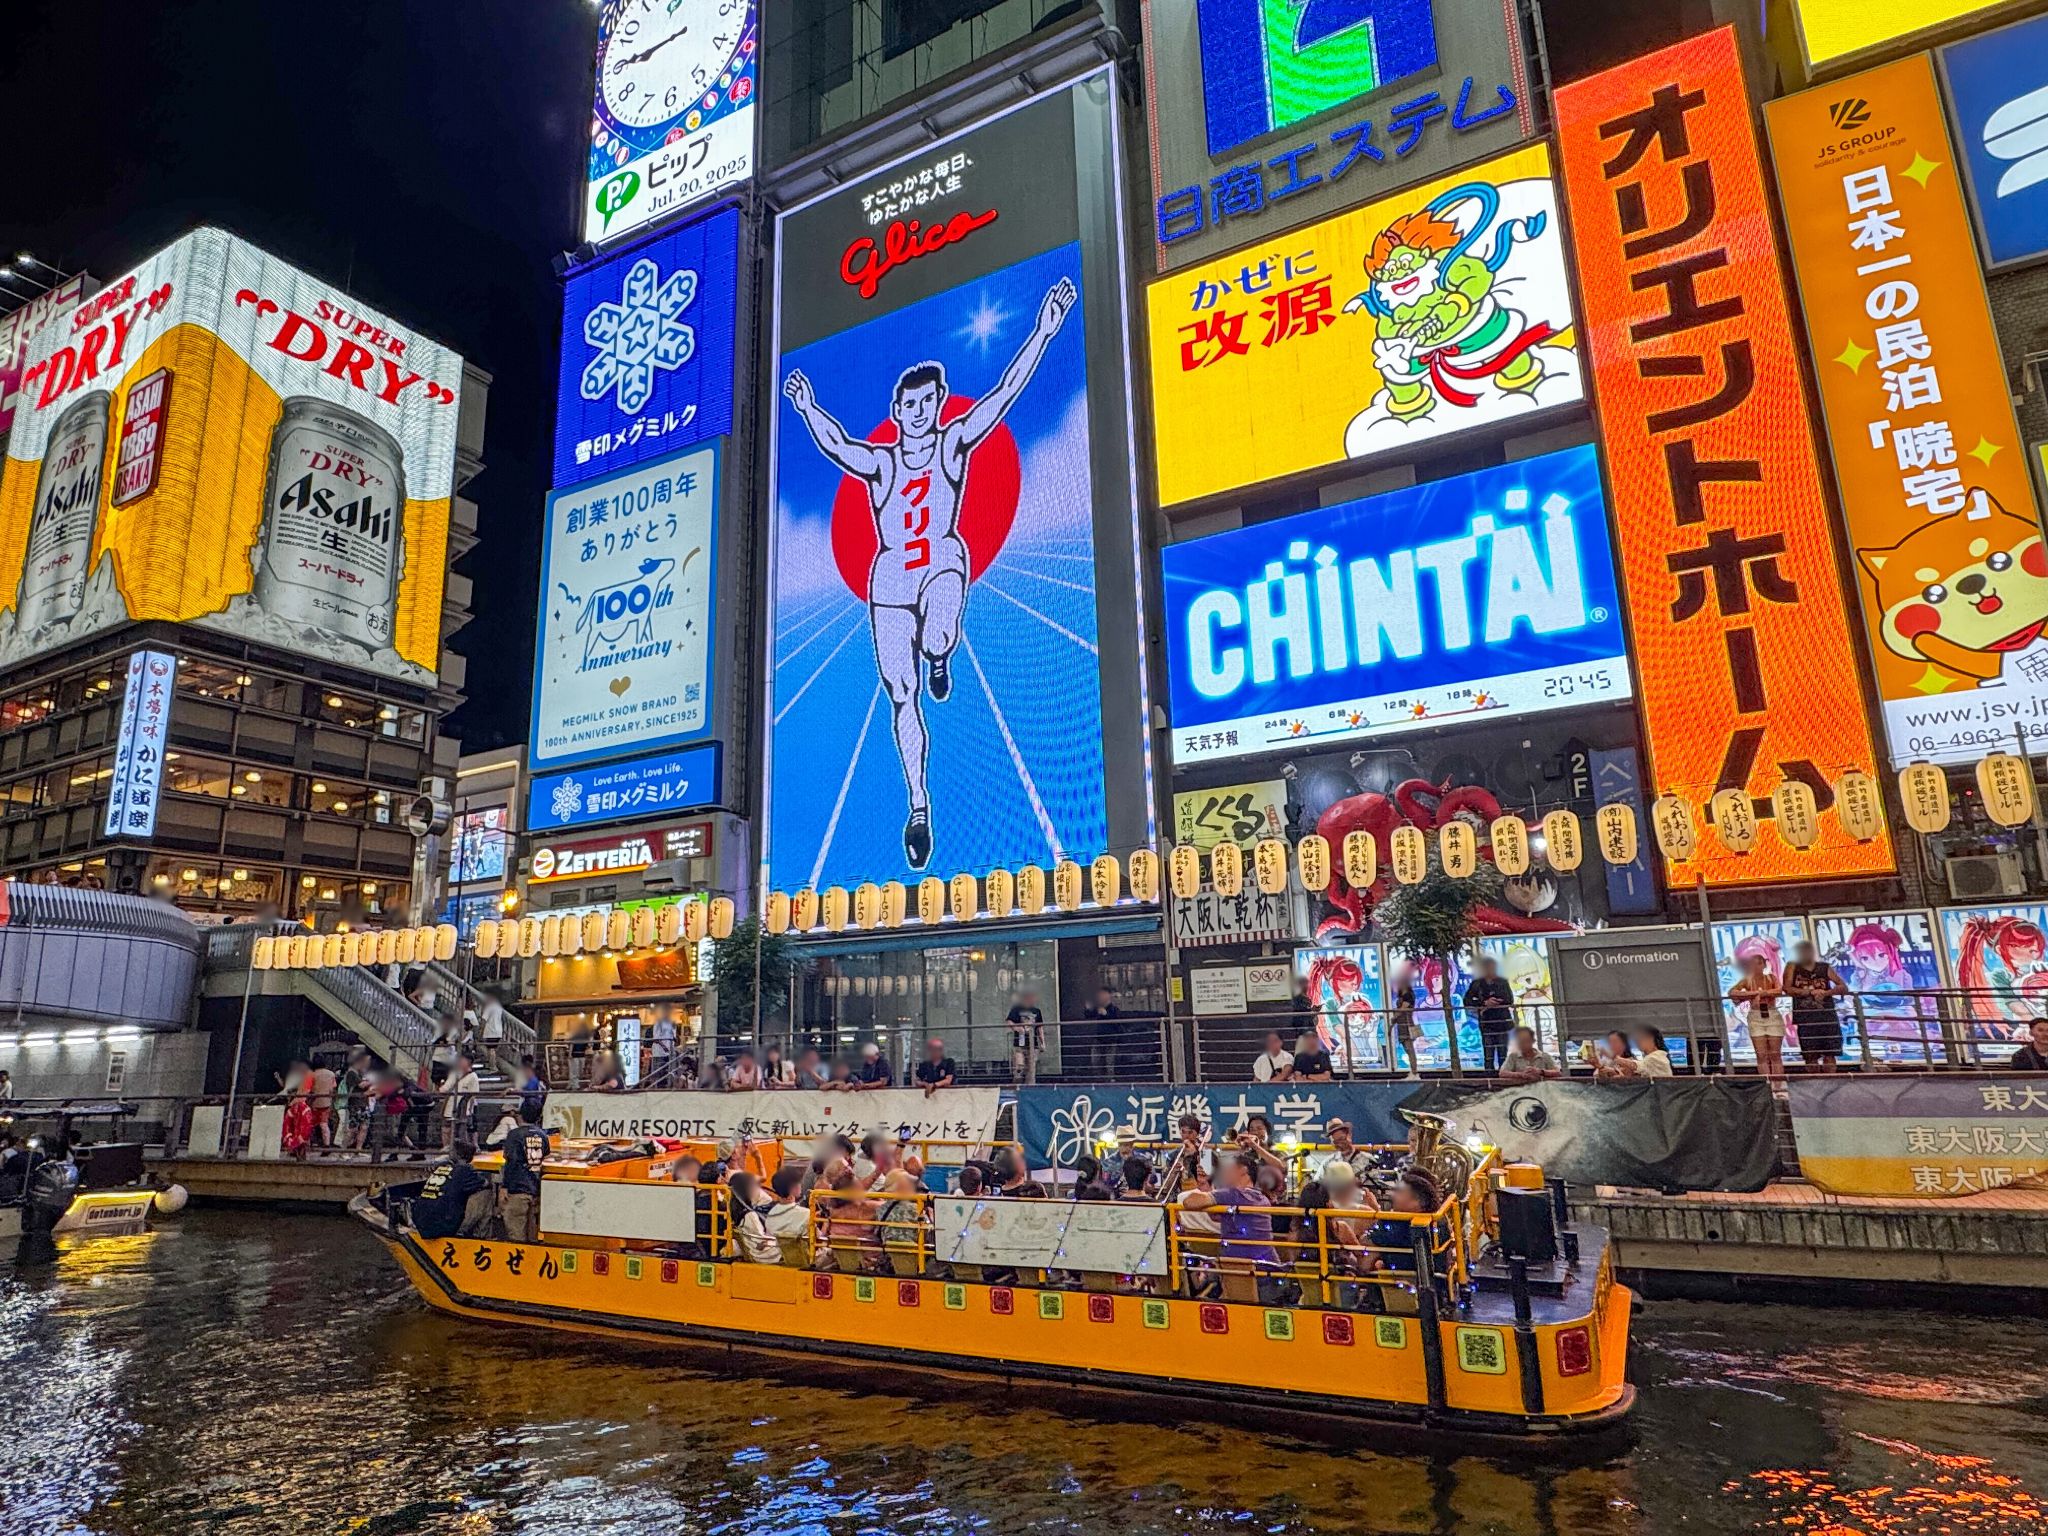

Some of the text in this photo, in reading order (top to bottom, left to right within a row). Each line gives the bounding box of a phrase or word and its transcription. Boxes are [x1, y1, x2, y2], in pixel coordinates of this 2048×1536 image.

[648, 133, 713, 189] ピップ
[1157, 74, 1518, 244] 日商エステム
[1813, 151, 1857, 169] solidarity
[1867, 136, 1907, 153] courage
[1817, 126, 1897, 158] JS GROUP
[648, 192, 676, 213] Jul.
[706, 155, 747, 181] 2025
[861, 152, 974, 212] すこやかな毎日、
[869, 176, 962, 226] ゆたかな人生
[1190, 250, 1318, 312] かぜに
[71, 275, 137, 334] SUPER
[1178, 273, 1337, 372] 改源
[314, 300, 406, 354] SUPER
[127, 378, 163, 426] ASAHI
[122, 423, 158, 466] 1889
[325, 444, 365, 467] SUPER
[574, 404, 698, 465] 雪印メグミルク
[36, 463, 99, 532] Asahi
[115, 458, 152, 499] OSAKA
[280, 471, 391, 545] Asahi
[565, 471, 698, 534] 創業100周年
[900, 469, 932, 571] グリコ
[321, 529, 349, 554] 生
[580, 513, 678, 563] ありがとう
[298, 557, 365, 588] スーパードライ
[596, 584, 675, 624] 100th
[574, 638, 673, 674] Anniversary
[562, 695, 678, 728] MEGMILK SNOW BRAND
[1264, 688, 1472, 730] 24時 6時 12時 18時
[544, 732, 569, 748] 100th
[1184, 730, 1239, 754] 天気予報
[586, 778, 689, 814] 雪印メグミルク
[593, 762, 683, 787] Love Earth. Love Life.
[1571, 753, 1588, 798] 2F
[1195, 793, 1265, 842] くくる
[1670, 800, 1688, 847] くれおーる
[1729, 793, 1750, 840] くれおーる
[556, 845, 654, 875] ZETTERIA
[952, 877, 963, 914] GIGO
[1606, 951, 1680, 965] information
[584, 1118, 625, 1138] MGM
[629, 1117, 716, 1138] RESORTS
[1903, 1124, 2048, 1155] 東大阪大
[440, 1240, 559, 1281] えちぜん
